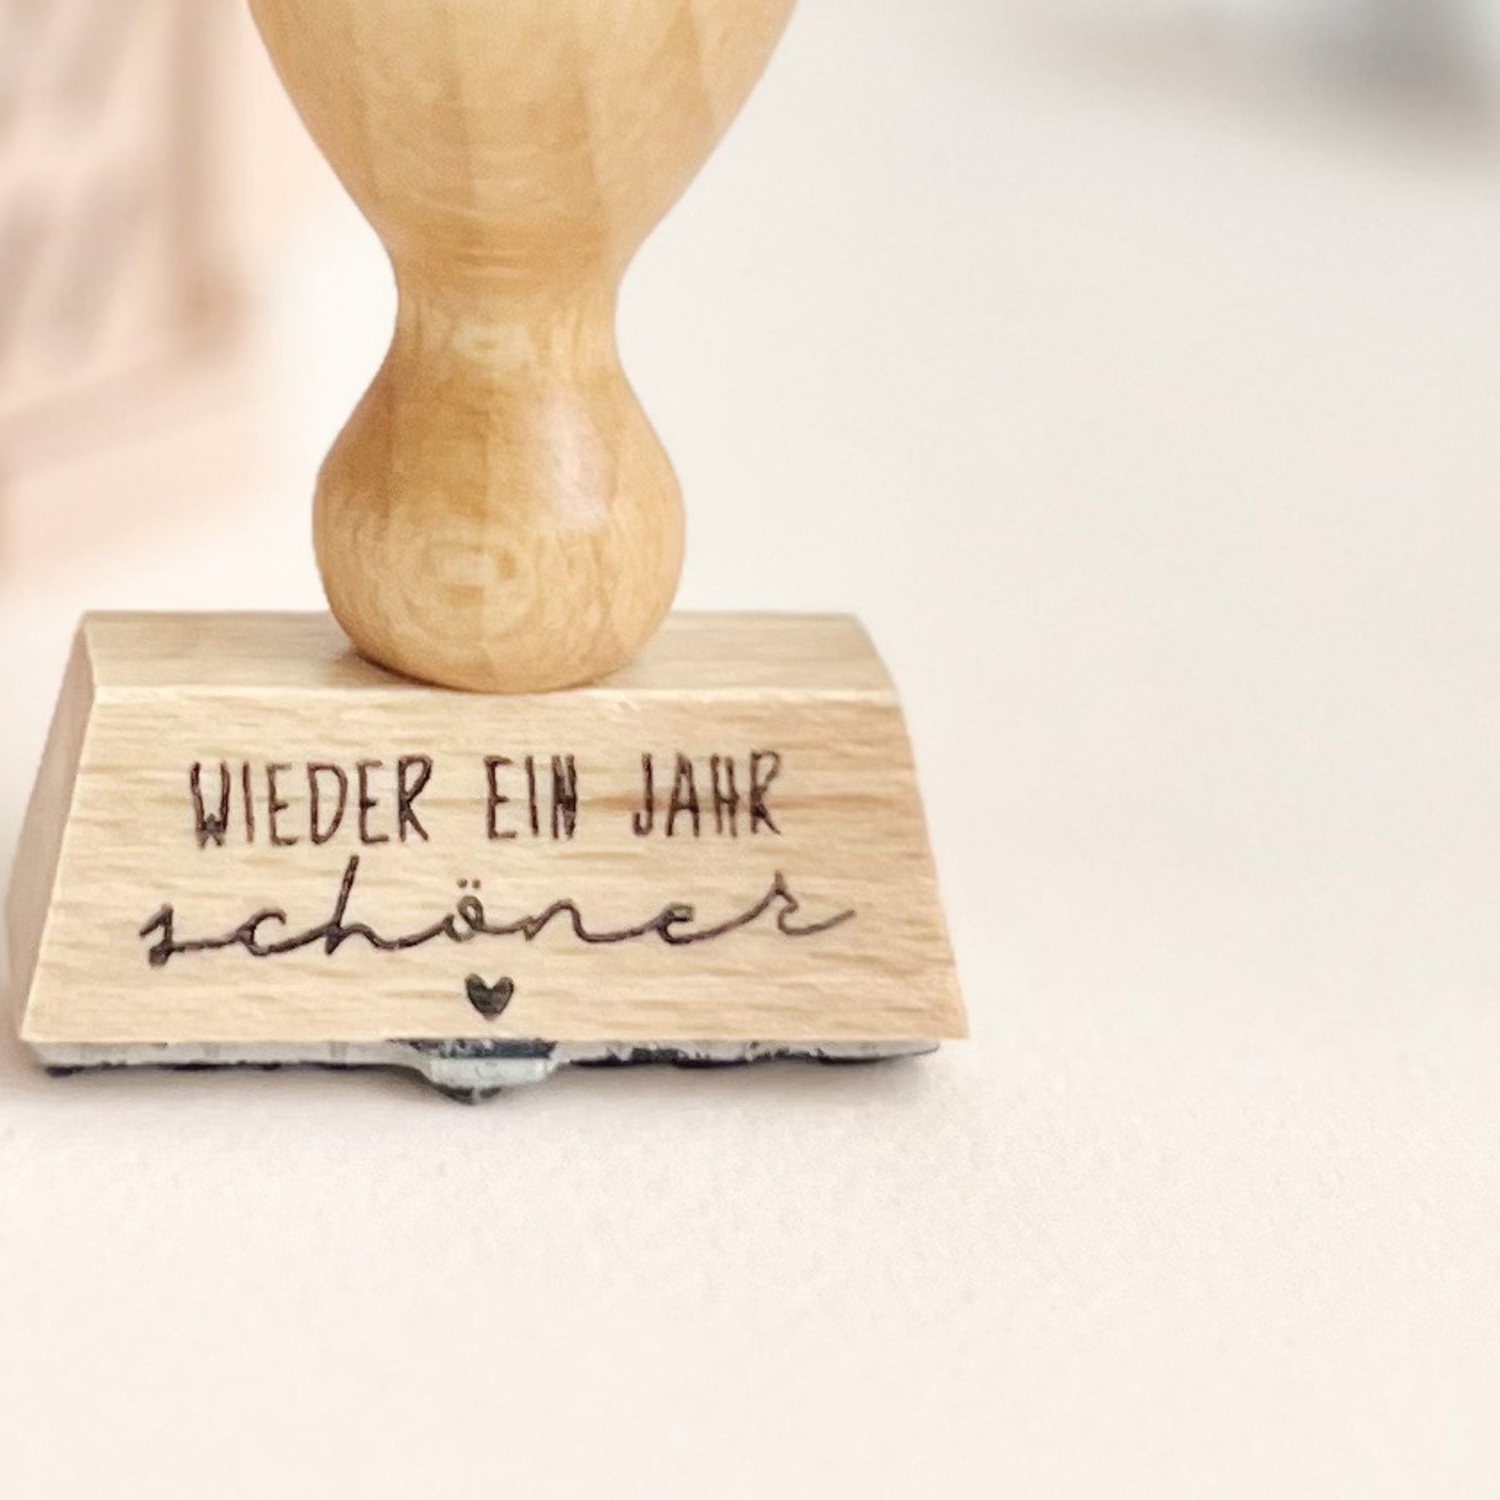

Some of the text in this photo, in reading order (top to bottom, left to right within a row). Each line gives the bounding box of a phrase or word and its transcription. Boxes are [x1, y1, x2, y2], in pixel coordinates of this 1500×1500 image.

[188, 748, 784, 847] WIEDER EIN JAHR
[138, 854, 856, 968] schöner
